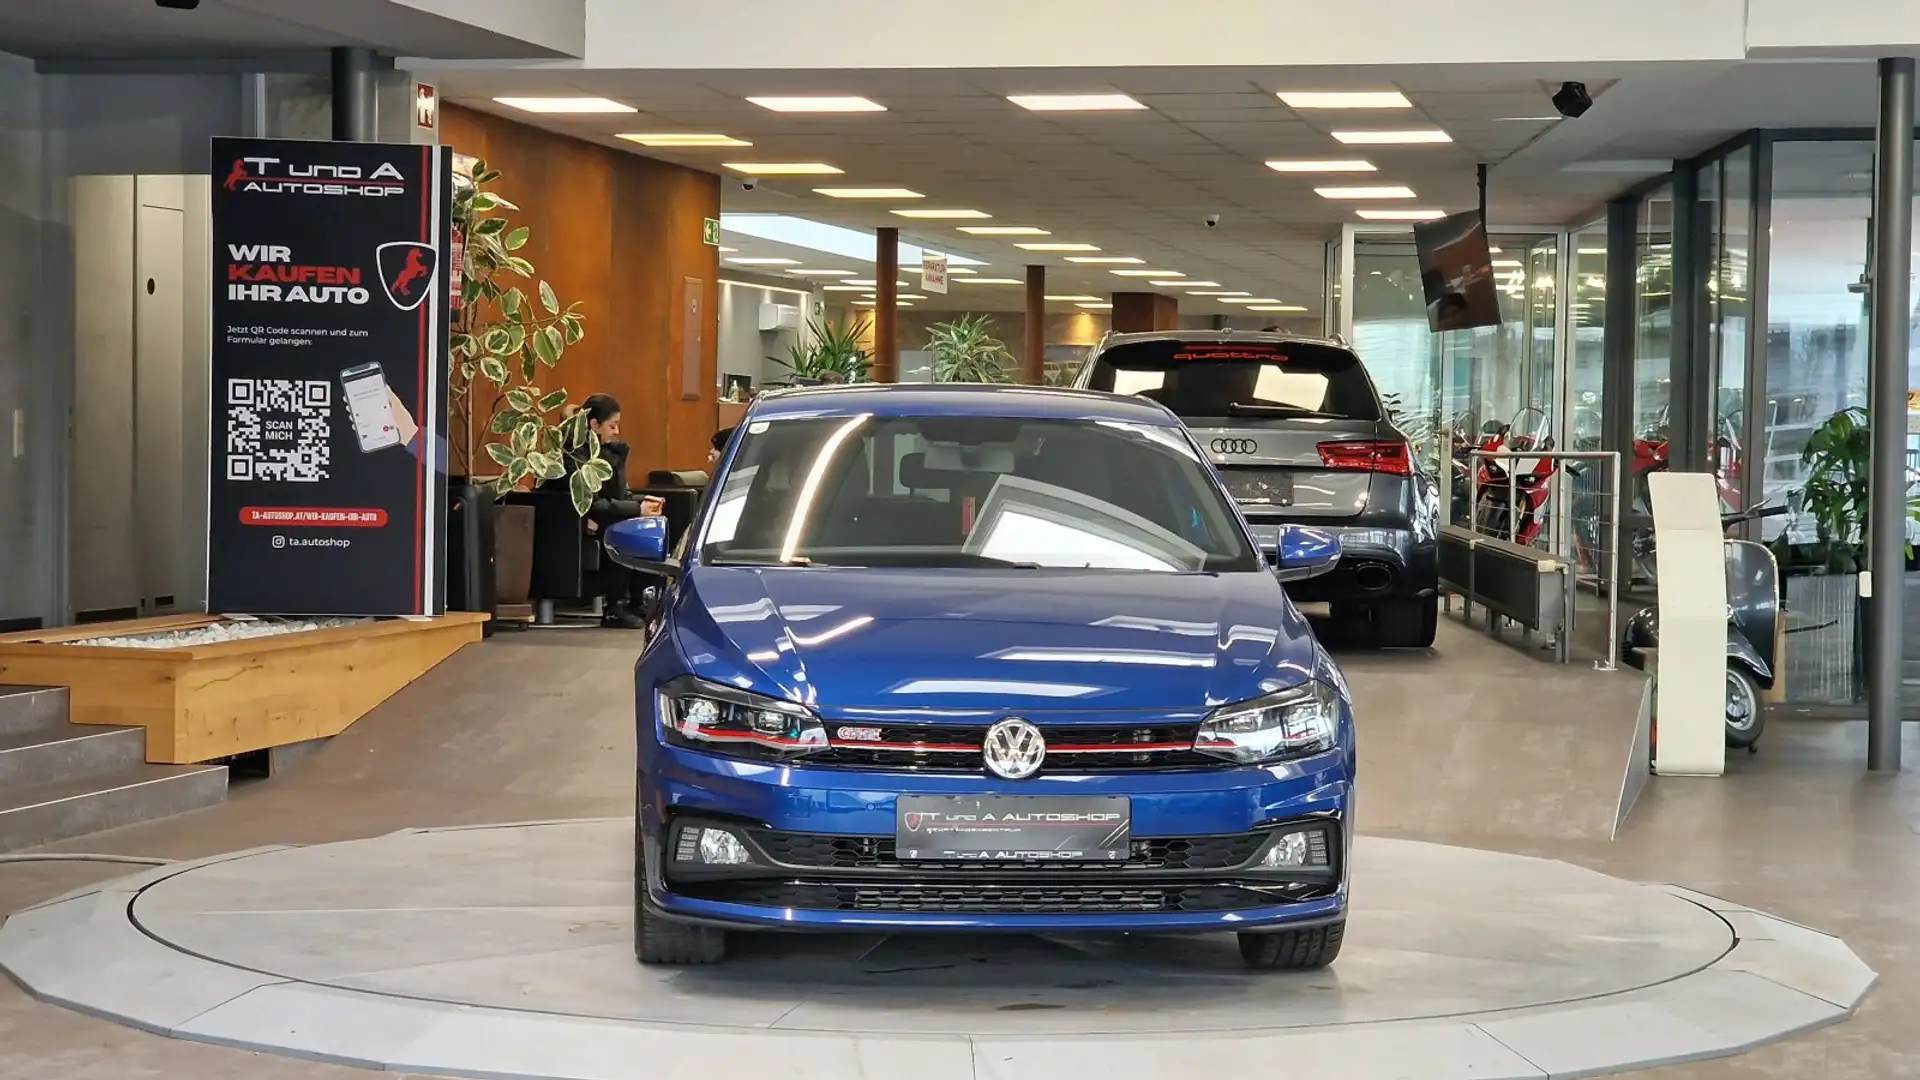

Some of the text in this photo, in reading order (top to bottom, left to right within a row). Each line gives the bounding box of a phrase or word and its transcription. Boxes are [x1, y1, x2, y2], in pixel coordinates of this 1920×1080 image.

[244, 157, 280, 175] T
[369, 162, 405, 180] A
[243, 181, 405, 197] AUTOSHOP
[228, 244, 292, 263] WIR
[228, 264, 361, 285] KAUFEN
[228, 284, 370, 305] IHR AUTO
[227, 325, 249, 334] Jetzt
[250, 326, 265, 335] QR
[266, 326, 289, 335] Code
[291, 328, 328, 336] scannen
[330, 328, 347, 336] und
[227, 335, 313, 347] Formular gelangen:
[1173, 352, 1289, 362] quattro
[265, 420, 293, 430] SCAN
[265, 431, 293, 441] MICH
[289, 537, 351, 549] ta.autoshop
[982, 812, 998, 821] A
[1002, 812, 1121, 821] AUTOSHOP
[978, 850, 990, 859] A
[994, 850, 1083, 859] AUTOSHOP
